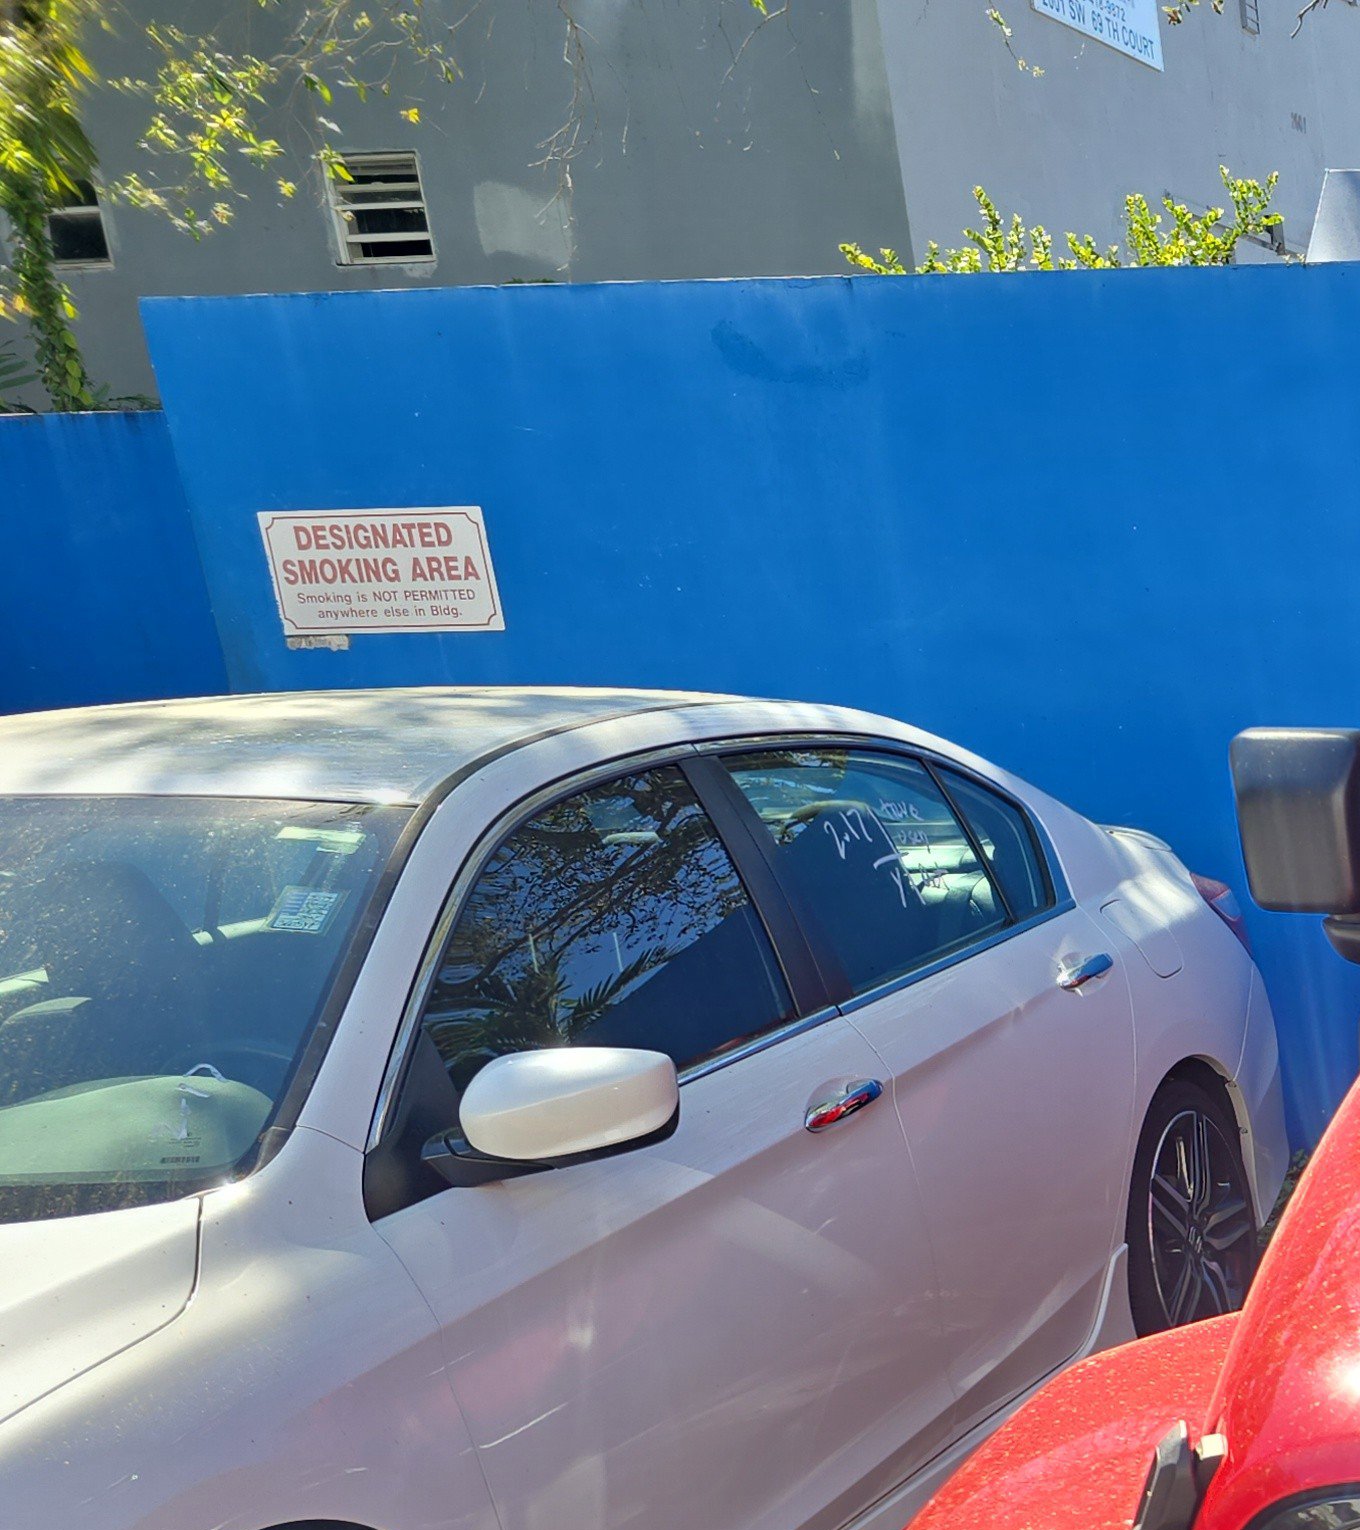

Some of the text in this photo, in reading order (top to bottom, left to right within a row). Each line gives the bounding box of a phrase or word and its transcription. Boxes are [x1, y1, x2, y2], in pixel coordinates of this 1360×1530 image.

[1121, 25, 1154, 60] COURT
[294, 522, 453, 551] DESIGNATED
[283, 556, 481, 585] SMOKING AREA
[297, 589, 475, 605] Smoking is NOT PERMITTED
[318, 605, 462, 619] anywhere else in Bldg.
